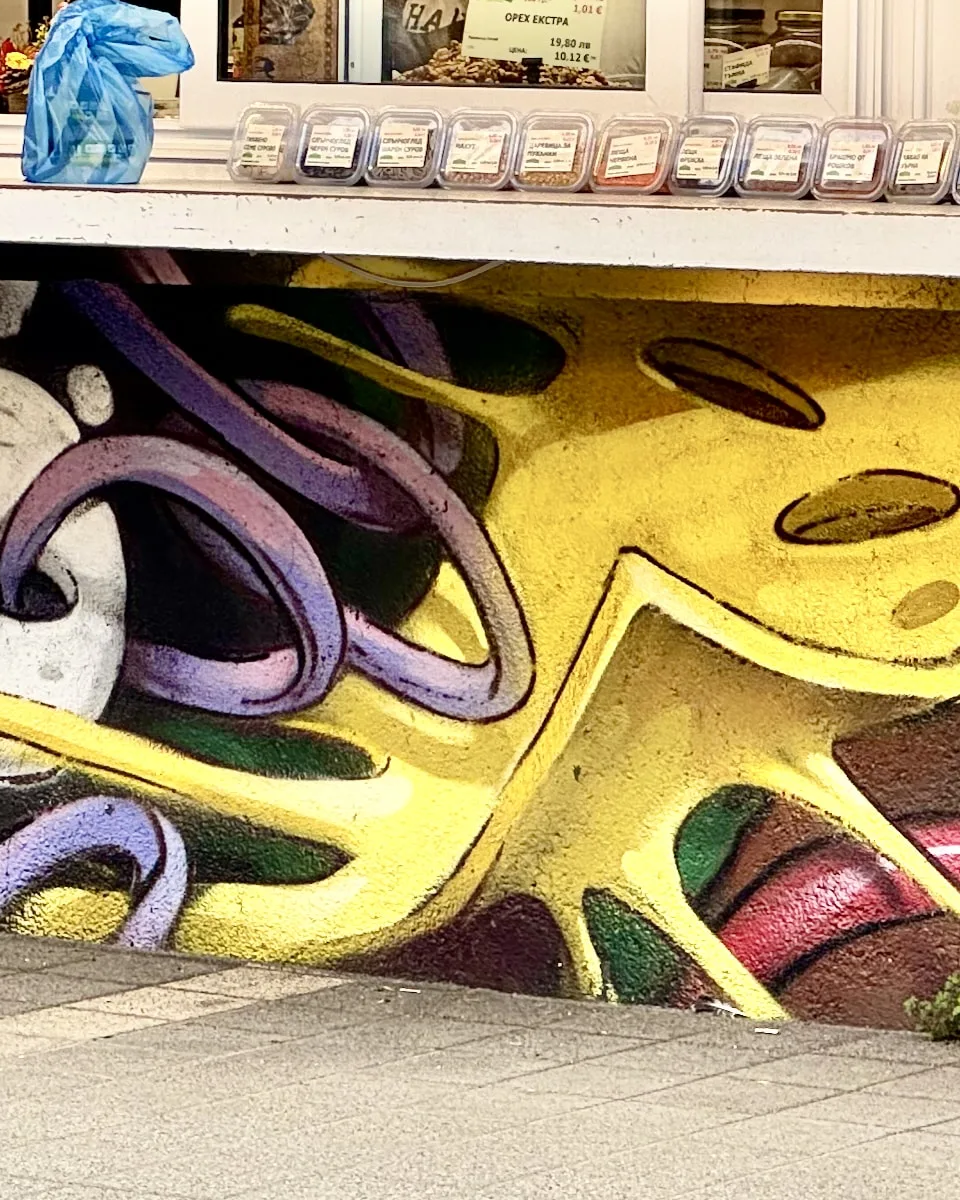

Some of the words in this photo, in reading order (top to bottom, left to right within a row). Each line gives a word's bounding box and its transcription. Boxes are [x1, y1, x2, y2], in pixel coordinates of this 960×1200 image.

[573, 4, 593, 14] 1,01
[596, 5, 603, 15] €
[505, 12, 530, 24] ОРЕХ
[532, 14, 569, 26] ЕКСТРА
[550, 37, 576, 49] 19,80
[578, 41, 591, 50] лв
[509, 46, 528, 55] ЦЕНА:
[554, 51, 581, 62] 10,12
[583, 53, 590, 63] €
